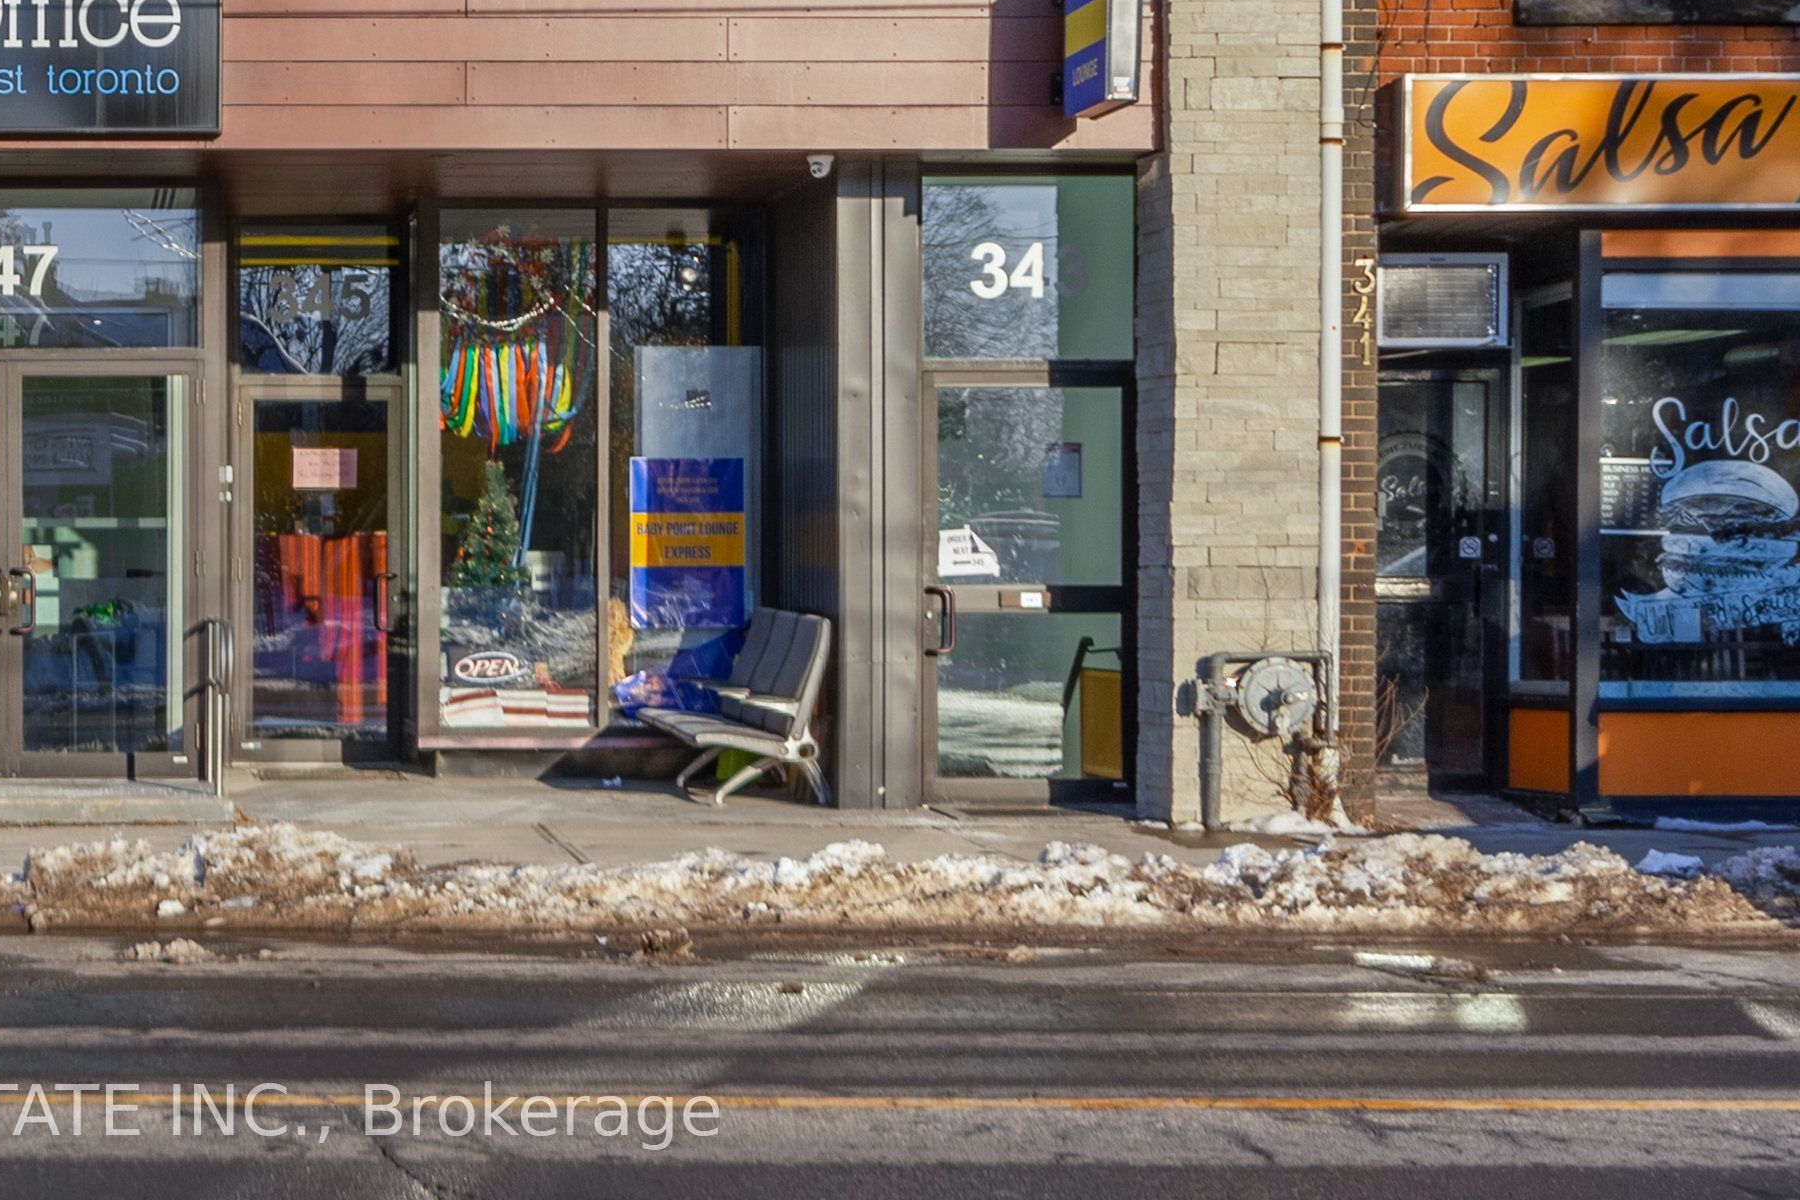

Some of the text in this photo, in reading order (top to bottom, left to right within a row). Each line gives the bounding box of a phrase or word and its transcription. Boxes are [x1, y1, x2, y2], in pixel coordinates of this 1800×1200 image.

[47, 64, 180, 94] toronto
[1072, 58, 1098, 87] LOUNGE
[268, 270, 371, 321] 345
[1353, 258, 1376, 366] 341
[637, 523, 739, 535] BABY POINT LOUNGE
[665, 546, 711, 559] EXPRESS
[455, 658, 518, 679] OPEN
